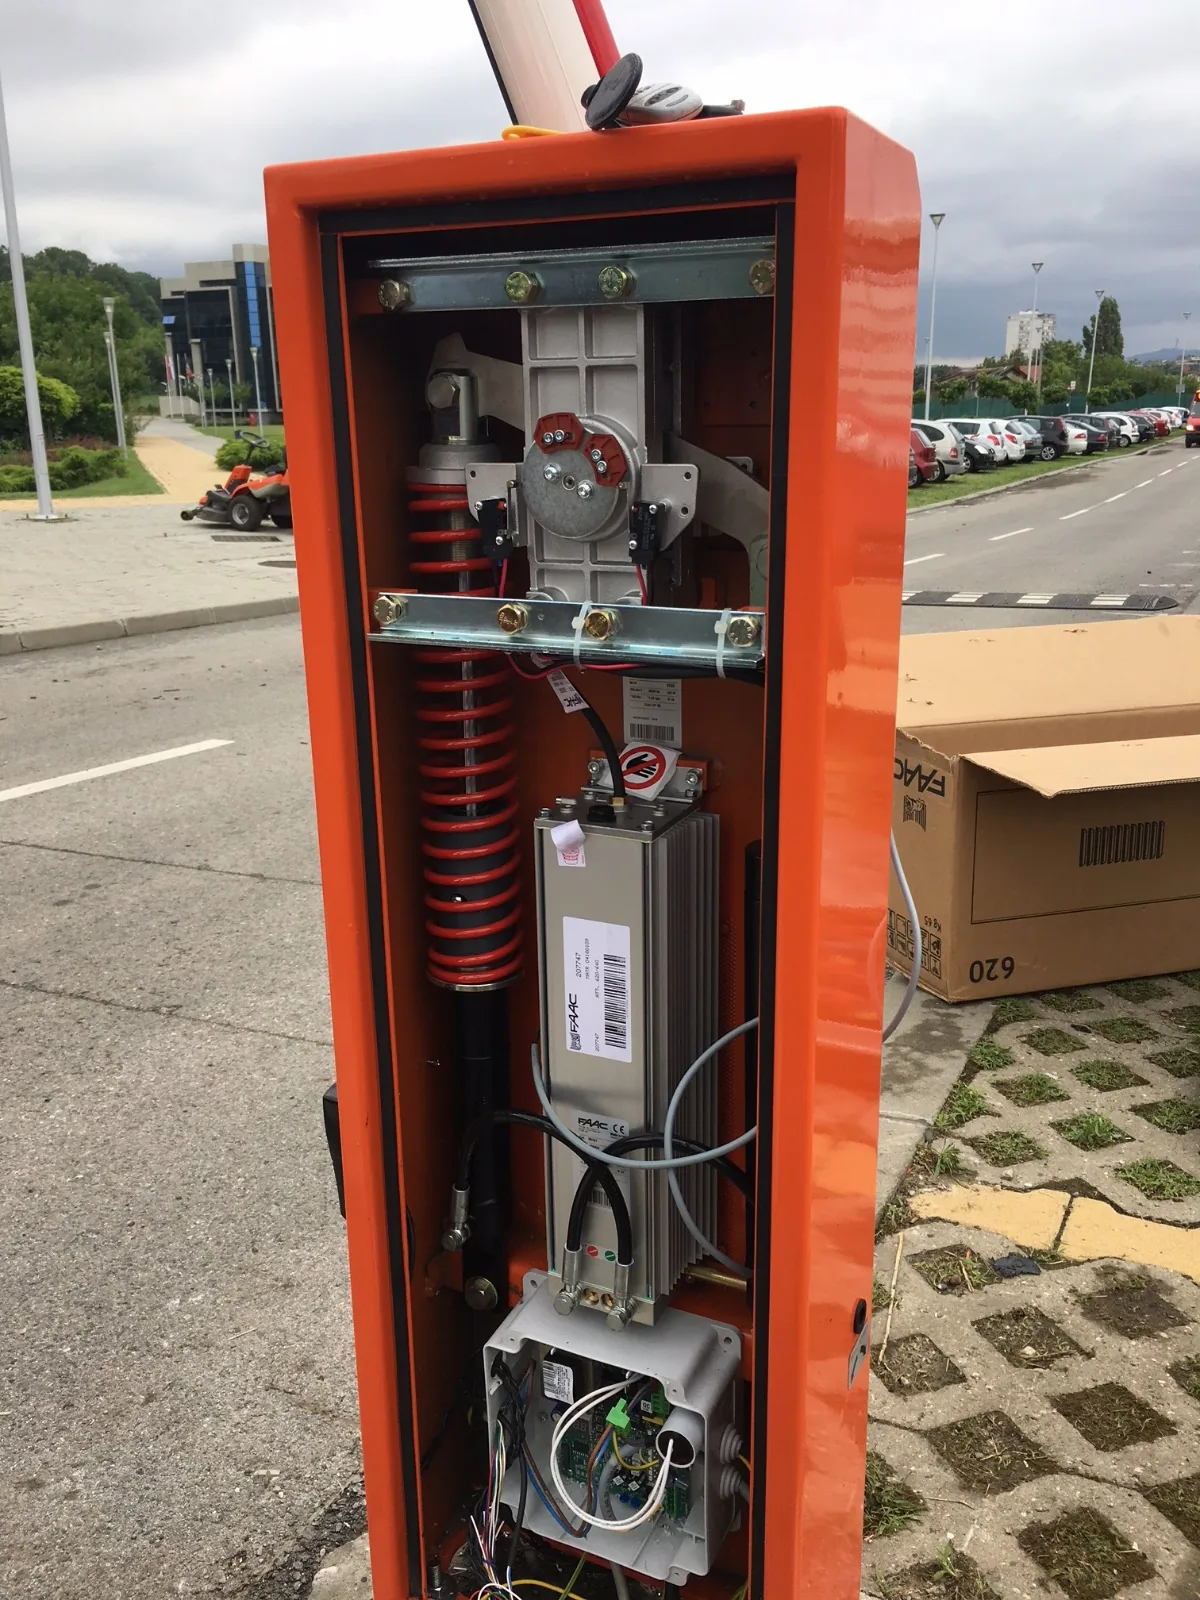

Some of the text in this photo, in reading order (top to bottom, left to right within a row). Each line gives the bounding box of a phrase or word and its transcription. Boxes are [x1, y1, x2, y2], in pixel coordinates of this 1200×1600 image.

[893, 758, 946, 797] FAAC
[924, 915, 942, 933] Kg 65
[969, 956, 1015, 984] 620
[568, 993, 579, 1033] FAAC
[577, 1117, 609, 1131] FAAC
